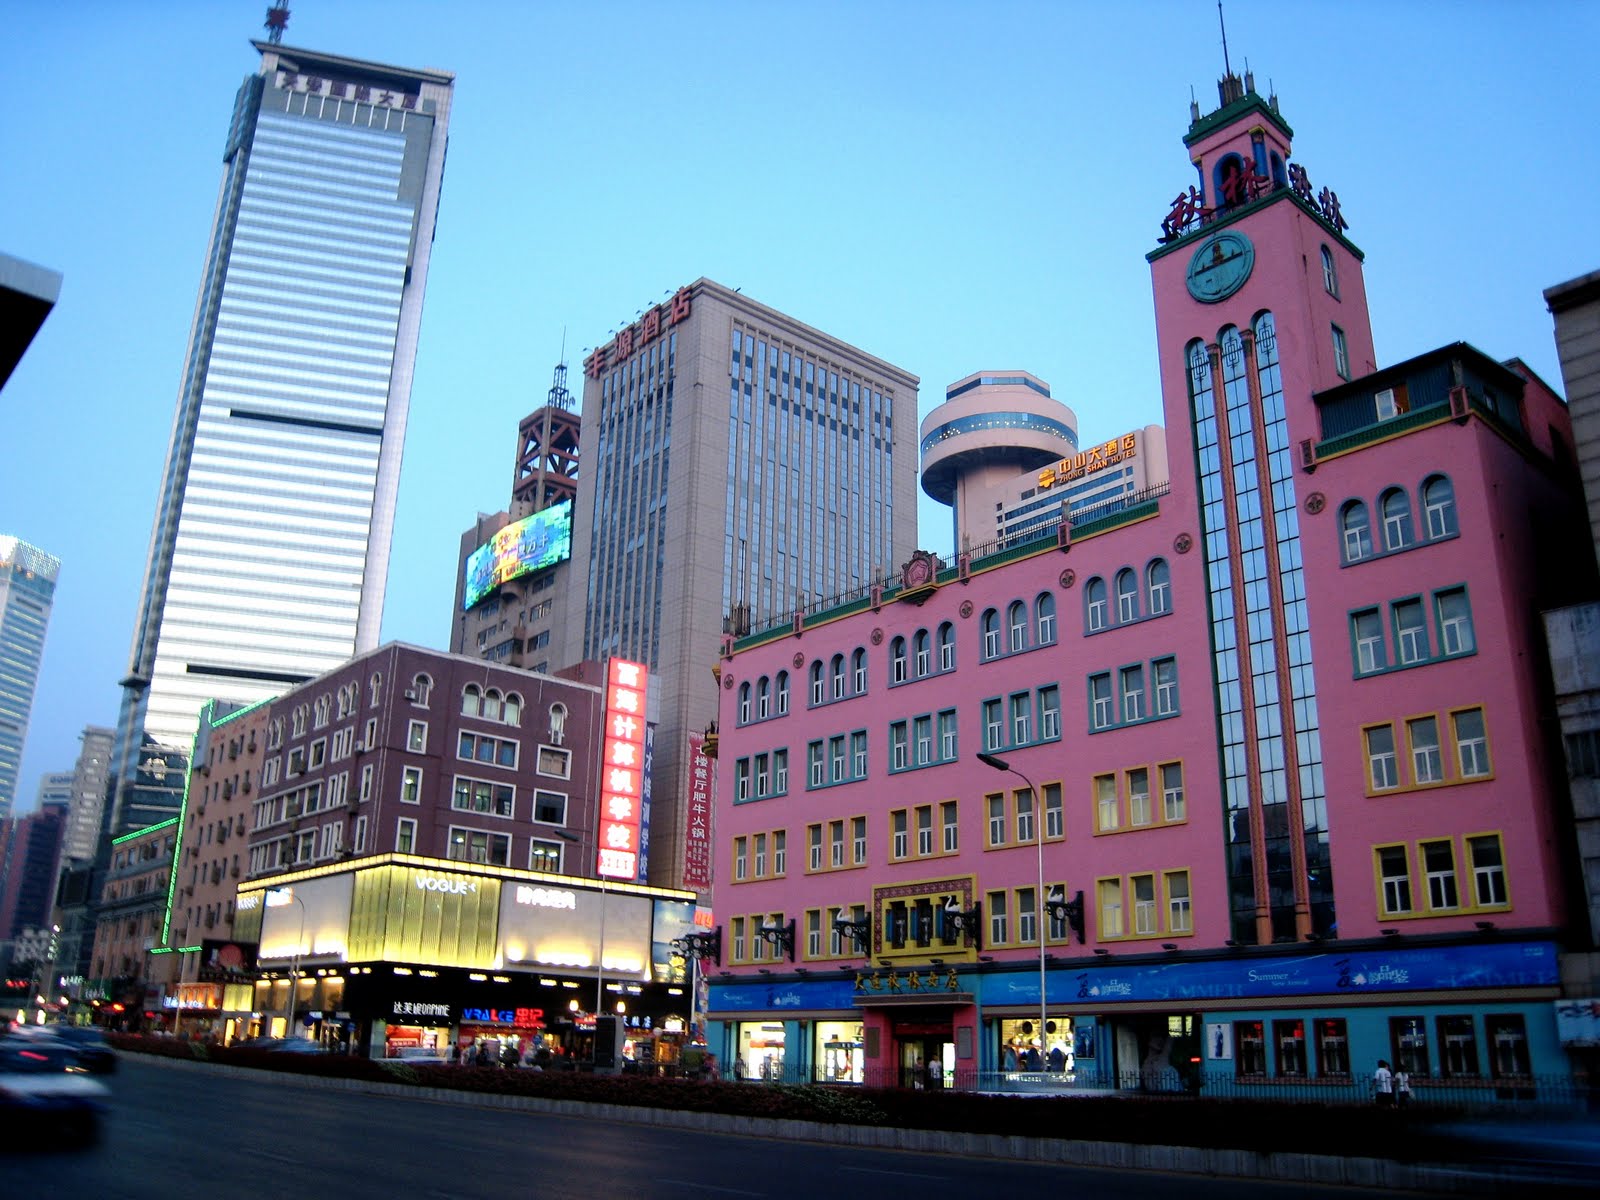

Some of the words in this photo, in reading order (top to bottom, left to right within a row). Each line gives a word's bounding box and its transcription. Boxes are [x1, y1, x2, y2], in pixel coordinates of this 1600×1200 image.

[586, 284, 693, 380] 丰源酒店
[1059, 433, 1136, 475] 中山大酒店
[1059, 468, 1084, 484] ZHONG
[1087, 459, 1108, 474] SHAN
[1111, 449, 1136, 464] HOTEL
[415, 875, 468, 895] VOGUE
[1248, 969, 1289, 983] Summer
